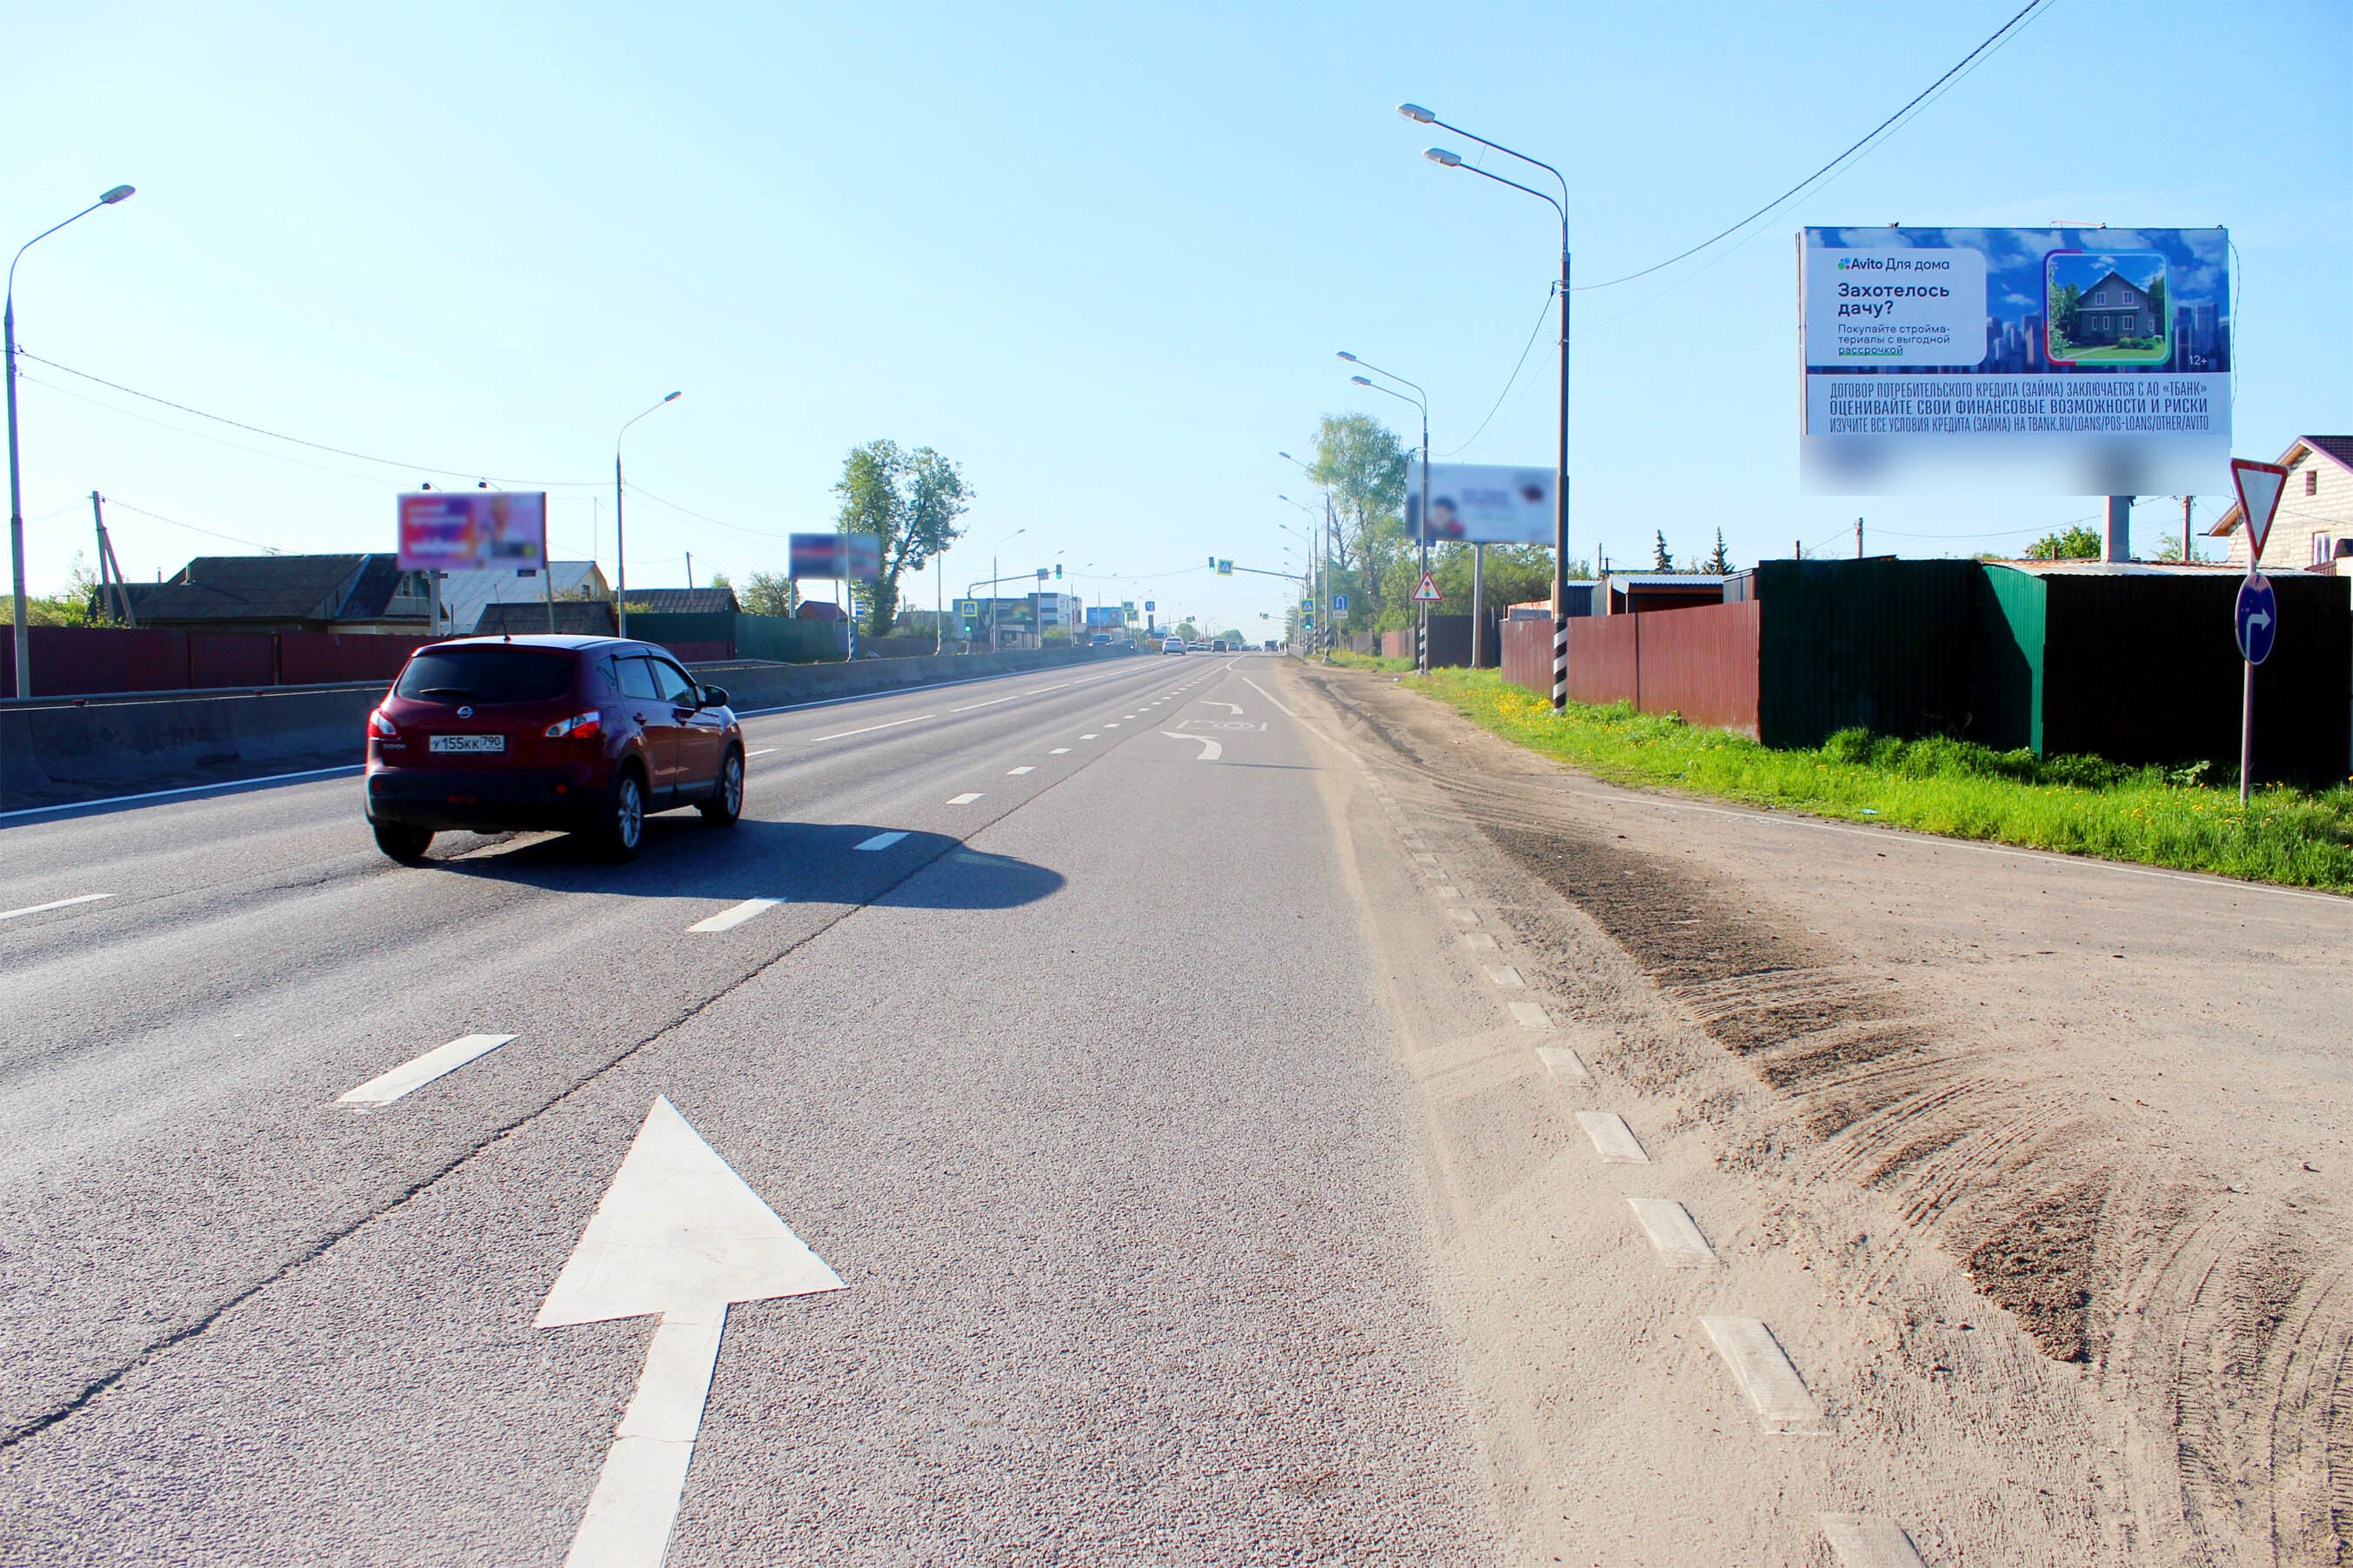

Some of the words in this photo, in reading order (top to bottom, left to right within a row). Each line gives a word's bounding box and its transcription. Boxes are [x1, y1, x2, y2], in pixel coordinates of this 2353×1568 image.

[1851, 258, 1882, 270] Avito
[1885, 258, 1911, 271] Для
[1915, 261, 1949, 271] дома
[1838, 283, 1949, 297] Захотелось
[1838, 300, 1894, 318] дачу?
[1838, 324, 1896, 336] Покупайте
[1899, 324, 1950, 335] стройма-
[1838, 337, 1885, 345] териалы
[1896, 335, 1950, 344] выгодной
[1838, 346, 1903, 356] рассрочкой
[2189, 355, 2208, 365] 12+
[1830, 383, 1874, 399] ДОГОВОР
[1877, 383, 1972, 397] ПОТРЕБИТЕЛЬСКОГО
[1976, 382, 2019, 398] КРЕДИТА
[2022, 380, 2063, 397] (ЗАЙМА)
[2067, 382, 2135, 397] ЗАКЛЮЧАЕТСЯ
[2137, 382, 2144, 397] С
[2147, 382, 2159, 397] АО
[2162, 382, 2208, 397] «ТБАНК»
[1830, 397, 1913, 417] ОЦЕНИВАЙТЕ
[1917, 400, 1950, 415] СВОИ
[1955, 399, 2045, 415] ФИНАНСОВЫЕ
[2050, 399, 2146, 414] ВОЗМОЖНОСТИ
[2151, 398, 2159, 414] И
[2165, 398, 2208, 413] РИСКИ
[1830, 417, 1868, 432] ИЗУЧИТЕ
[1871, 417, 1887, 432] ВСЕ
[1888, 417, 1929, 432] УСЛОВИЯ
[1932, 417, 1970, 433] КРЕДИТА
[1973, 415, 2010, 432] (ЗАЙМА)
[2014, 417, 2025, 431] НА
